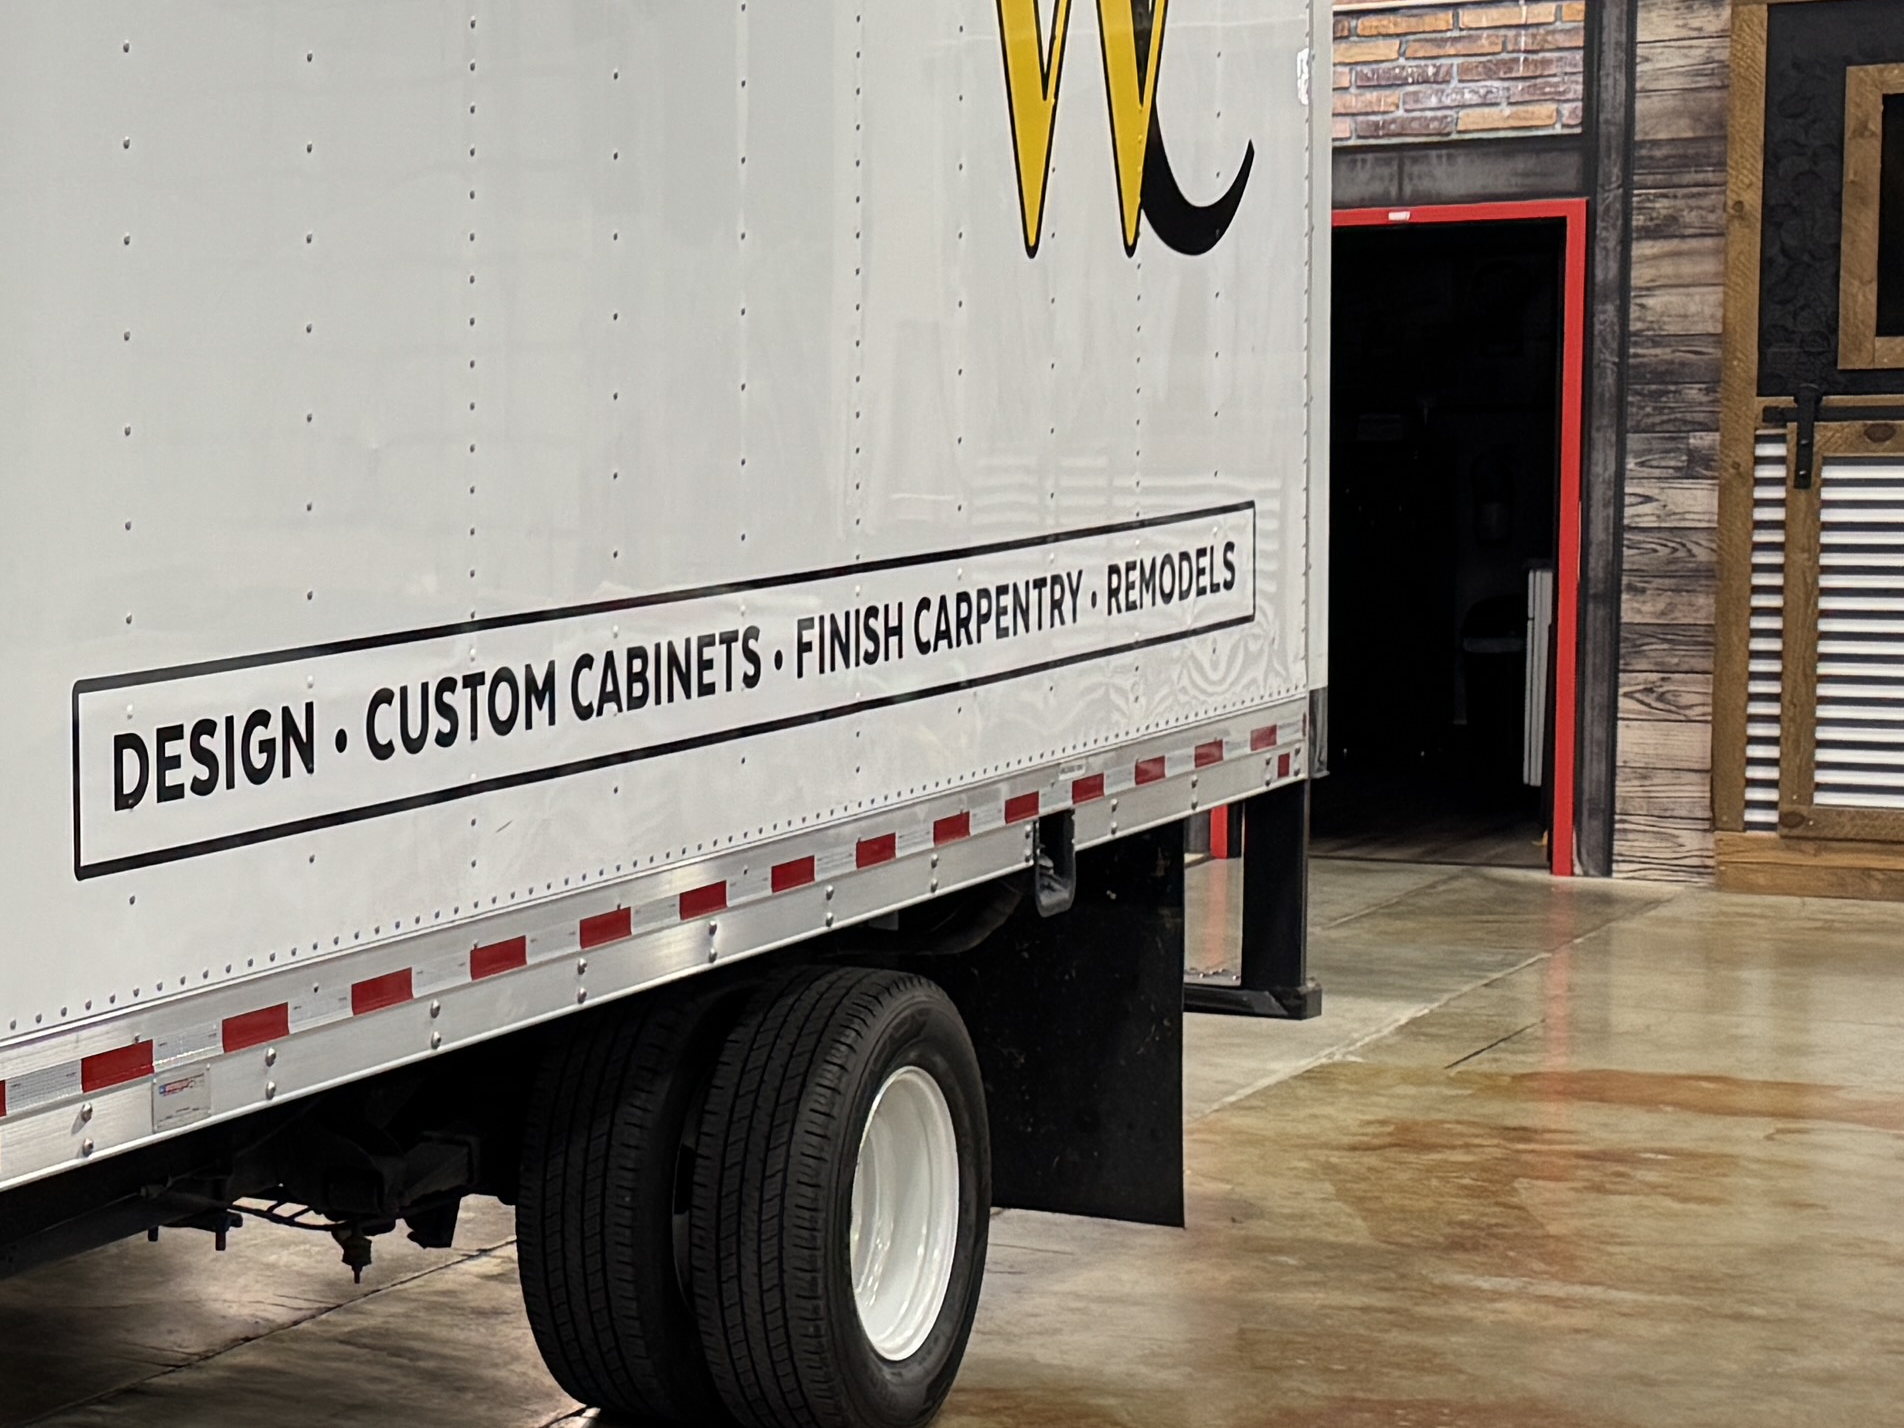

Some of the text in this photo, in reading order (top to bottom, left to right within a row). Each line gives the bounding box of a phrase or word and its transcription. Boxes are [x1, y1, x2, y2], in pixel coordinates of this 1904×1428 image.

[113, 540, 1237, 812] DESIGN CUSTOM CABINETS FINISH CARPENTRY REMODELS
